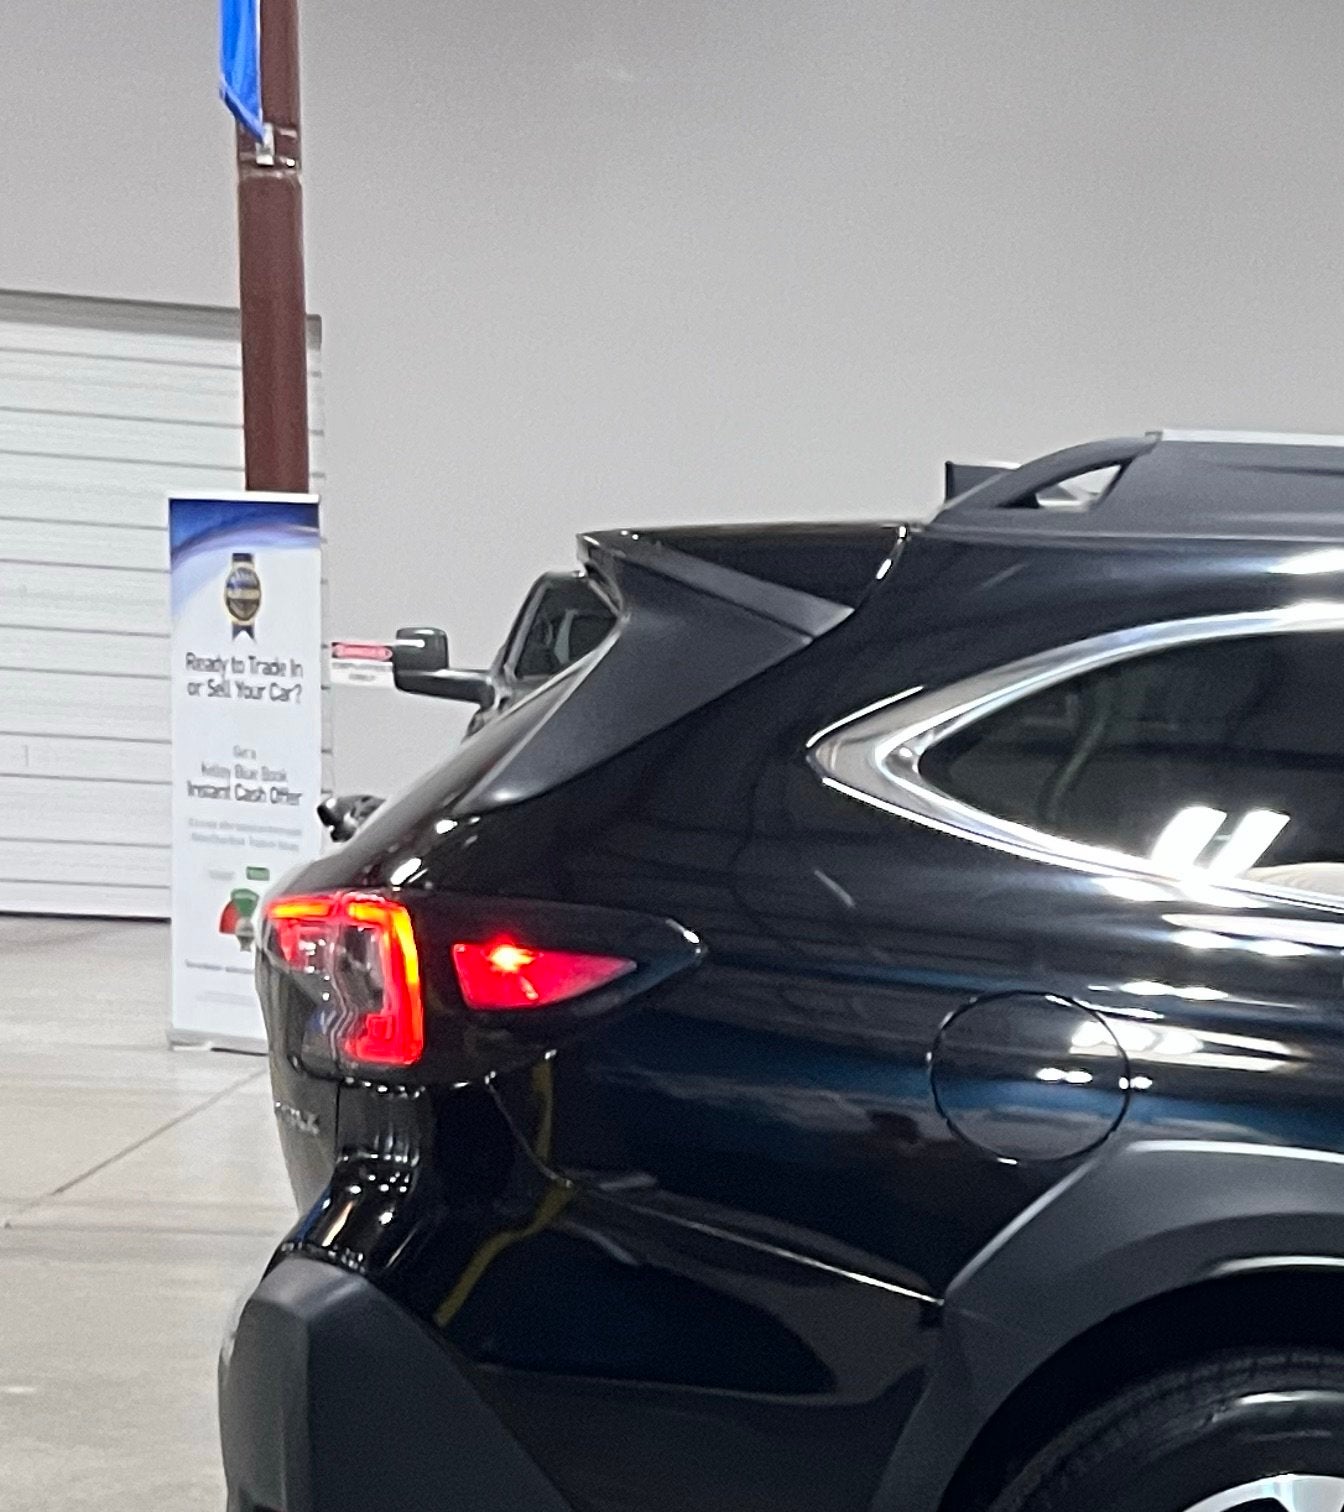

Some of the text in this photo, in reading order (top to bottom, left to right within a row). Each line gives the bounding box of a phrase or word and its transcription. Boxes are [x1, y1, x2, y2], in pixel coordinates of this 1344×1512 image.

[231, 656, 245, 674] to
[187, 679, 302, 704] or Sell Your Car?
